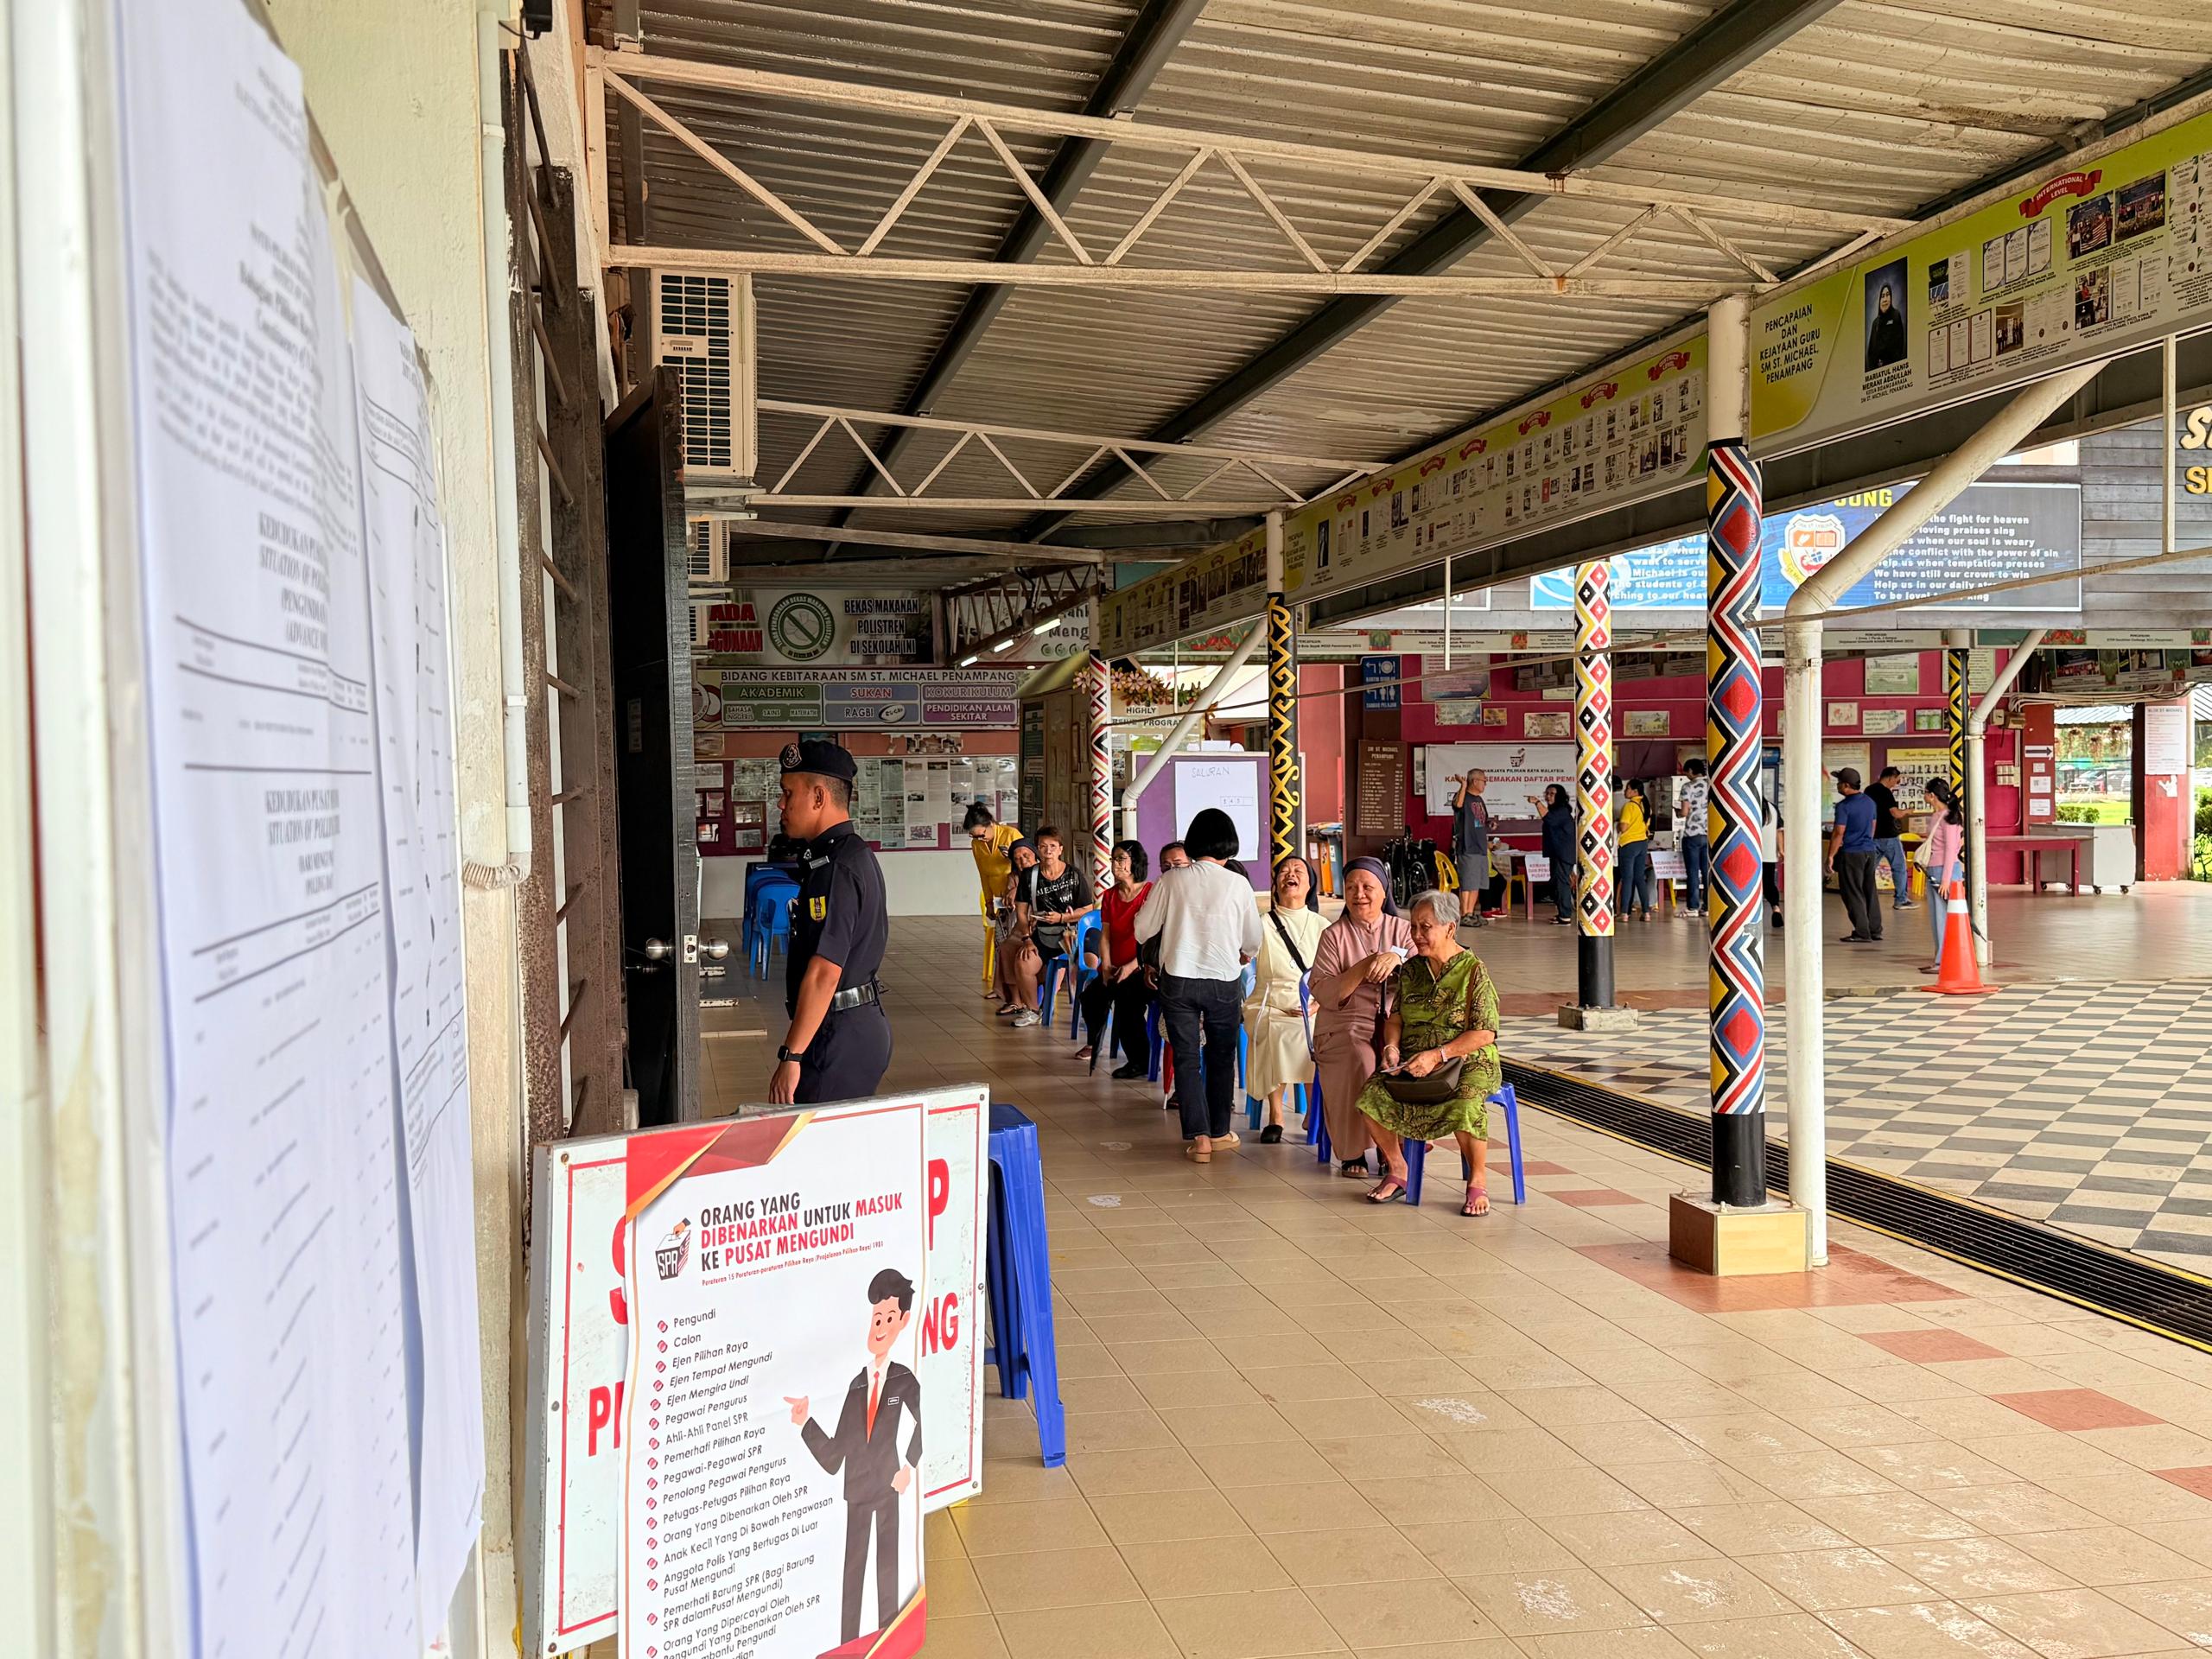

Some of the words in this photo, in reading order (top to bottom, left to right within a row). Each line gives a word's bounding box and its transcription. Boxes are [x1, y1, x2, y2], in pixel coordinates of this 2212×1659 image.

[2036, 175, 2083, 200] INTERNATIONAL
[2050, 187, 2068, 200] LEVEL
[1765, 304, 1813, 334] PENCAPAIAN
[1782, 324, 1797, 339] DAN
[1760, 337, 1797, 360] KEJAYAAN
[1800, 328, 1820, 345] GURU
[1761, 361, 1771, 373] SM
[1766, 359, 1813, 384] PENAMPANG
[1920, 527, 1949, 536] loving
[1953, 527, 1991, 536] praises
[1994, 527, 2015, 536] sing
[1949, 515, 1974, 524] fight
[1976, 515, 1990, 524] for
[1993, 515, 2029, 524] heaven
[1908, 548, 1948, 556] conflict
[1951, 548, 1974, 556] with
[1977, 548, 1993, 556] the
[1997, 550, 2027, 559] power
[2031, 549, 2042, 557] of
[1916, 537, 1944, 545] when
[2005, 539, 2036, 548] weary
[1633, 569, 1675, 577] Michael
[1948, 559, 2003, 569] temptation
[2012, 570, 2029, 579] win
[1874, 581, 1897, 589] Help
[1949, 581, 1974, 589] daily
[709, 603, 755, 621] ADA
[844, 600, 873, 613] BEKAS
[874, 599, 918, 613] MAKANAN
[857, 619, 905, 634] POLISTREN
[850, 640, 859, 653] DI
[862, 639, 900, 653] SEKOLAH
[904, 639, 915, 653] INI
[721, 671, 767, 681] BIDANG
[772, 671, 847, 681] KEBITARAAN
[850, 671, 867, 681] SM
[870, 671, 885, 681] ST.
[889, 671, 938, 681] MICHAEL
[942, 671, 1014, 681] PENAMPANG
[740, 688, 805, 698] AKADEMIK
[850, 688, 892, 698] SUKAN
[925, 687, 1011, 698] KOKURIKULUM
[845, 708, 873, 717] RAGBI
[950, 712, 988, 721] SEKITAR
[701, 1200, 754, 1227] ORANG
[760, 1192, 800, 1216] YANG
[702, 1212, 798, 1249] DIBENARKAN
[804, 1202, 850, 1227] UNTUK
[855, 1192, 902, 1217] MASUK
[702, 1250, 719, 1272] KE
[726, 1240, 772, 1267] PUSAT
[777, 1223, 854, 1255] MENGUNDI
[658, 1251, 679, 1279] SPR
[674, 1308, 716, 1327] Pengundi
[674, 1333, 702, 1348] Calon
[672, 1357, 691, 1369] Ejen
[695, 1348, 723, 1362] Pilihan
[726, 1341, 748, 1354] Raya
[670, 1376, 690, 1388] Ejen
[693, 1367, 726, 1381] Tempat
[728, 1351, 772, 1372] Mengundi
[667, 1395, 686, 1407] Ejen
[690, 1384, 727, 1400] Mengira
[729, 1376, 749, 1389] Undi
[665, 1408, 705, 1425] Pegawai
[708, 1395, 747, 1414] Pengurus
[665, 1424, 704, 1445] Ahli-Ahli
[707, 1416, 731, 1431] Panel
[734, 1412, 748, 1424] SPR
[664, 1444, 711, 1465] Pemerhati
[713, 1435, 741, 1449] Pilihan
[743, 1426, 766, 1440] Raya
[664, 1450, 745, 1484] Pegawai-Pegawai
[748, 1445, 762, 1459] SPR
[664, 1483, 705, 1503] Penolong
[709, 1468, 747, 1488] Pegawai
[748, 1457, 786, 1478] Pengurus
[664, 1491, 738, 1524] Petugas-Petugas
[740, 1483, 767, 1498] Pilihan
[769, 1473, 791, 1488] Raya
[664, 1529, 692, 1543] Orang
[695, 1519, 718, 1533] Yang
[721, 1500, 771, 1523] Dibenarkan
[772, 1493, 792, 1506] Oleh
[794, 1486, 808, 1498] SPR
[664, 1548, 688, 1564] Anak
[691, 1540, 713, 1554] Kecil
[715, 1531, 738, 1547] Yang
[740, 1526, 748, 1536] Di
[751, 1516, 779, 1533] Bawah
[781, 1497, 833, 1522] Pengawasan
[664, 1564, 704, 1585] Anggota
[706, 1554, 726, 1567] Polis
[728, 1546, 750, 1560] Yang
[753, 1533, 790, 1552] Bertugas
[791, 1526, 800, 1536] Di
[802, 1521, 819, 1533] Luar
[664, 1583, 688, 1599] Pusat
[691, 1563, 736, 1588] Mengundi
[664, 1592, 710, 1618] Pemerhati
[712, 1581, 743, 1600] Barung
[745, 1573, 760, 1586] SPR
[762, 1564, 785, 1583] (Bagi
[786, 1554, 816, 1572] Barung
[664, 1619, 679, 1632] SPR
[736, 1578, 783, 1602] Mengundi)
[664, 1635, 693, 1651] Orang
[696, 1624, 719, 1639] Yang
[721, 1603, 768, 1630] Dipercayai
[771, 1595, 790, 1609] Oleh
[709, 1632, 731, 1649] Yang
[734, 1612, 783, 1637] Dibenarkan
[785, 1603, 804, 1616] Oleh
[806, 1595, 821, 1609] SPR
[736, 1624, 776, 1649] Pengundi
